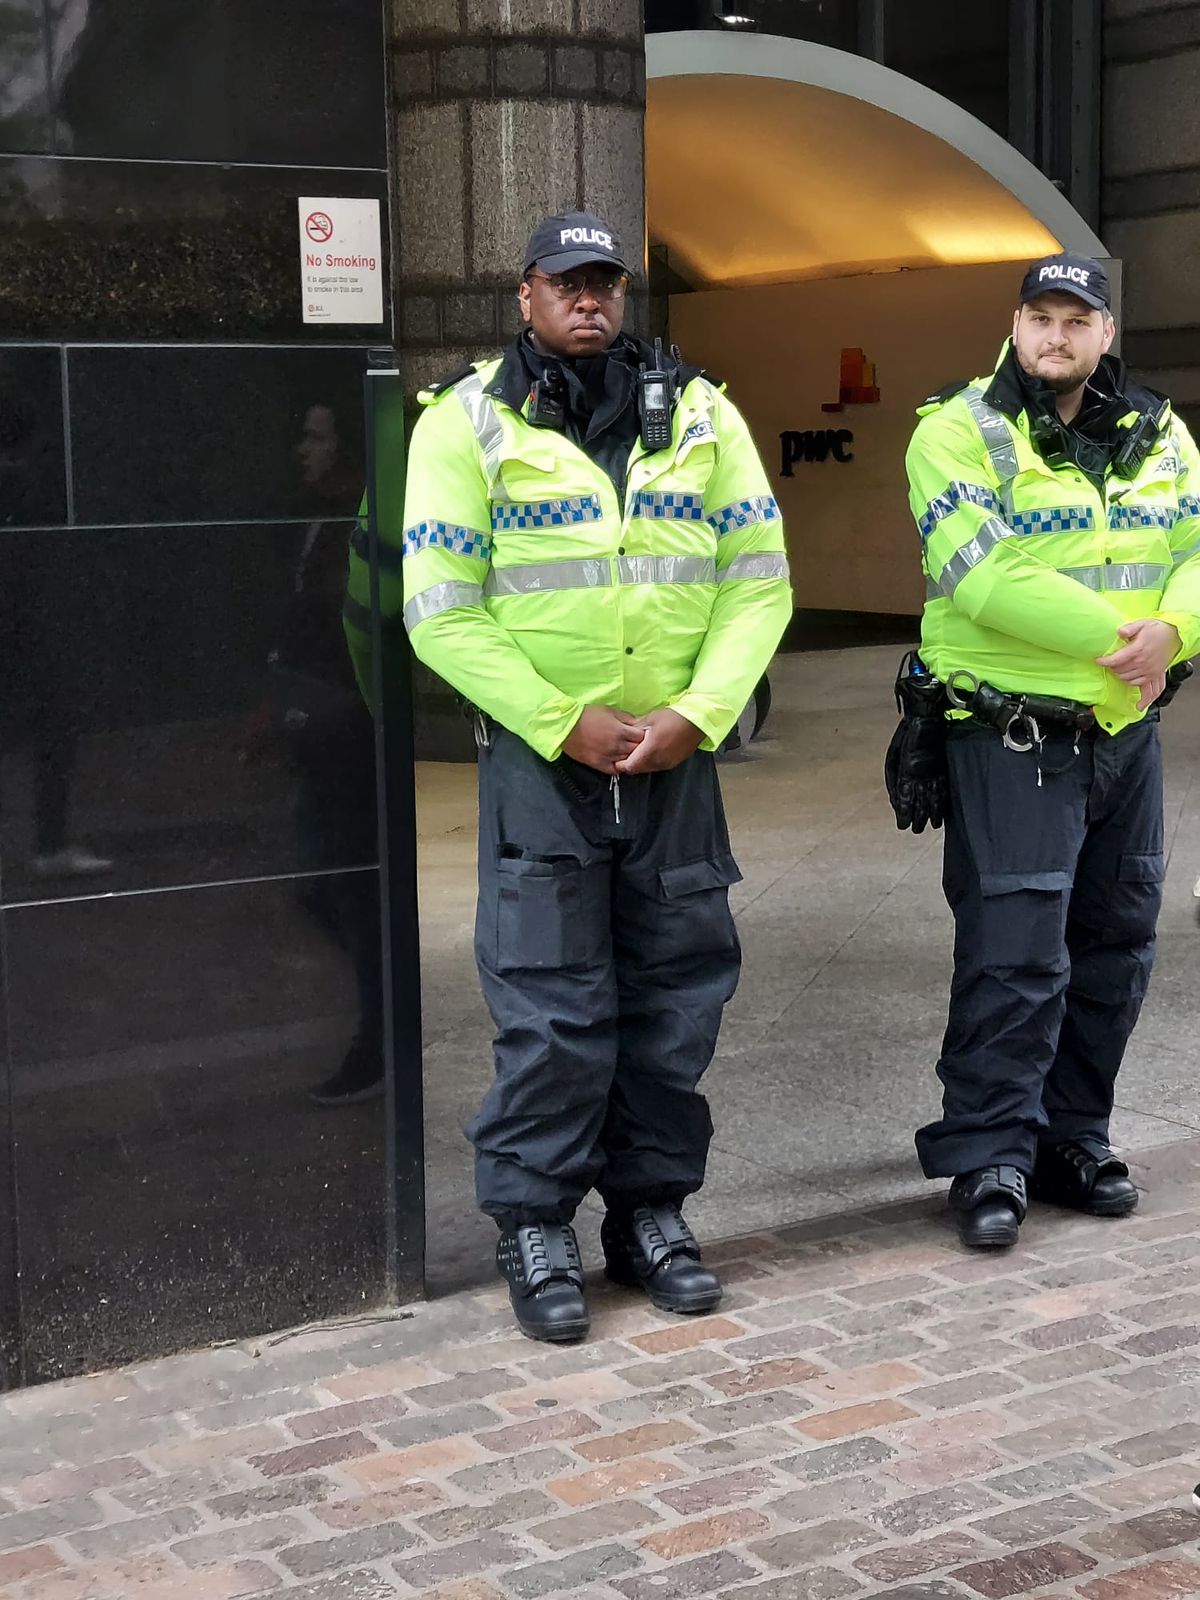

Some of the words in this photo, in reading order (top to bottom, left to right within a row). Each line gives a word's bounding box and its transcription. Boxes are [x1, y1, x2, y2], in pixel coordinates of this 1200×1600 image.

[560, 227, 613, 251] POLICE
[306, 254, 321, 266] No
[326, 254, 376, 271] Smoking
[1039, 264, 1090, 287] POLICE
[681, 421, 714, 444] LICE
[779, 429, 854, 477] pwc
